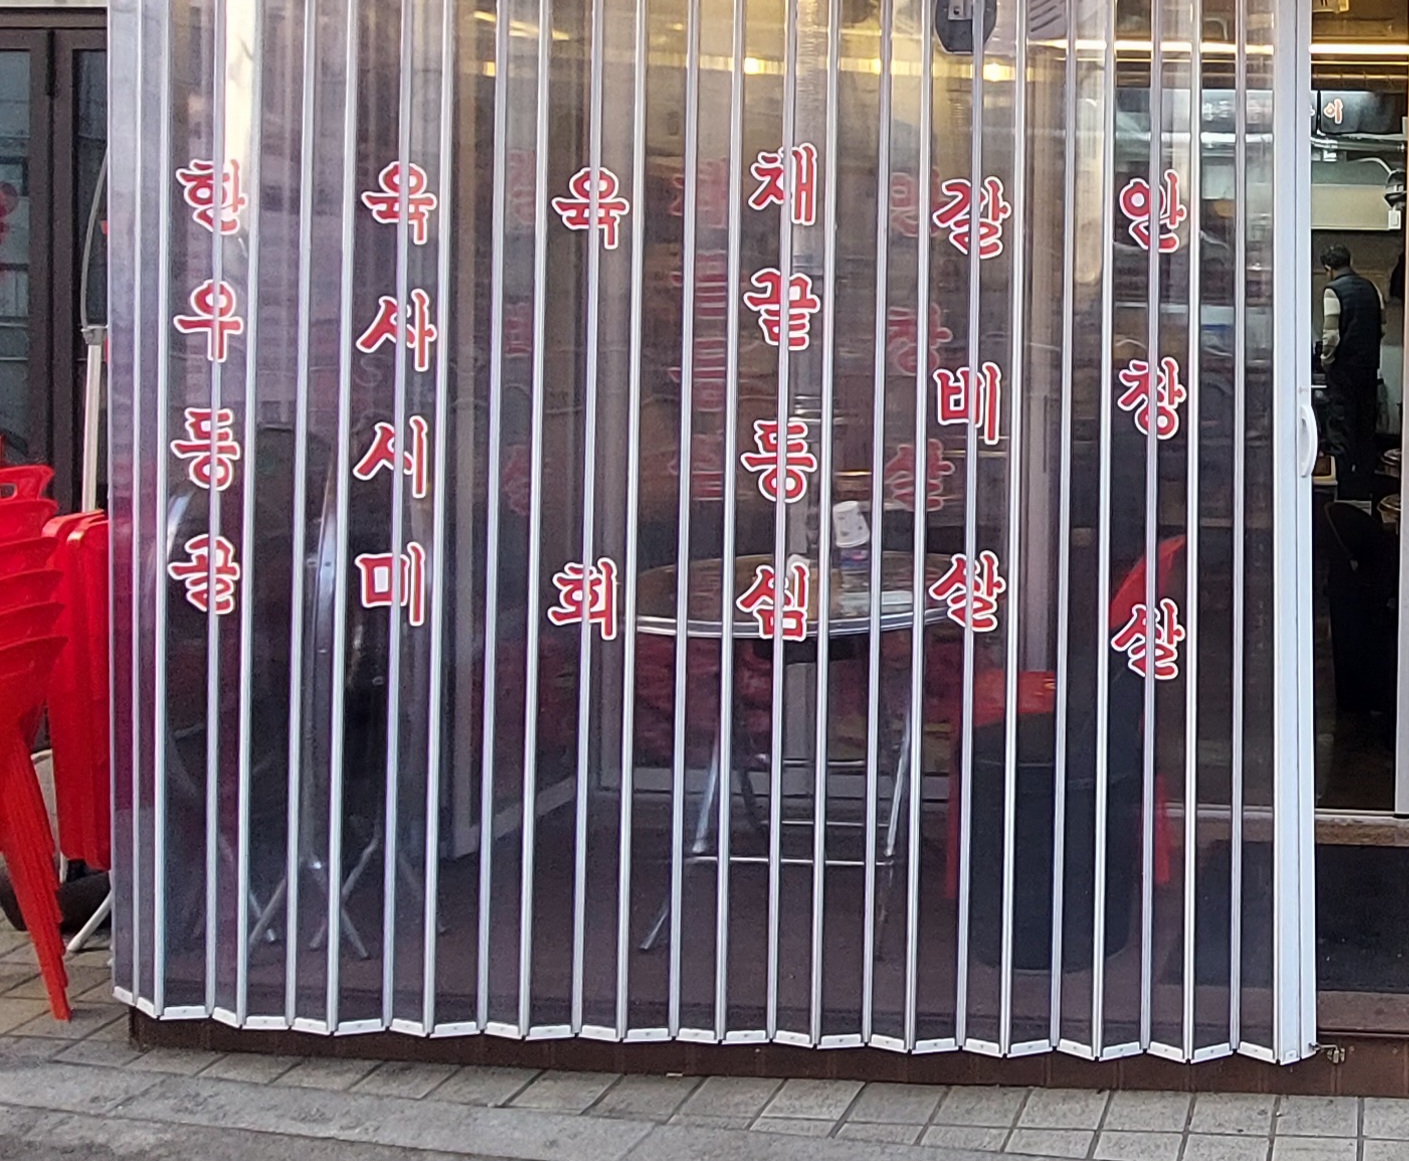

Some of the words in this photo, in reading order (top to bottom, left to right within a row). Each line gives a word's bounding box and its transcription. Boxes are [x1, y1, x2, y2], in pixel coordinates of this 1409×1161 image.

[168, 159, 248, 615] 한우등골
[353, 160, 438, 627] 육사시미
[548, 166, 630, 641] 육회
[737, 142, 820, 642] 채끝등심
[929, 177, 1011, 633] 갈비살
[1111, 169, 1186, 680] 안창살
